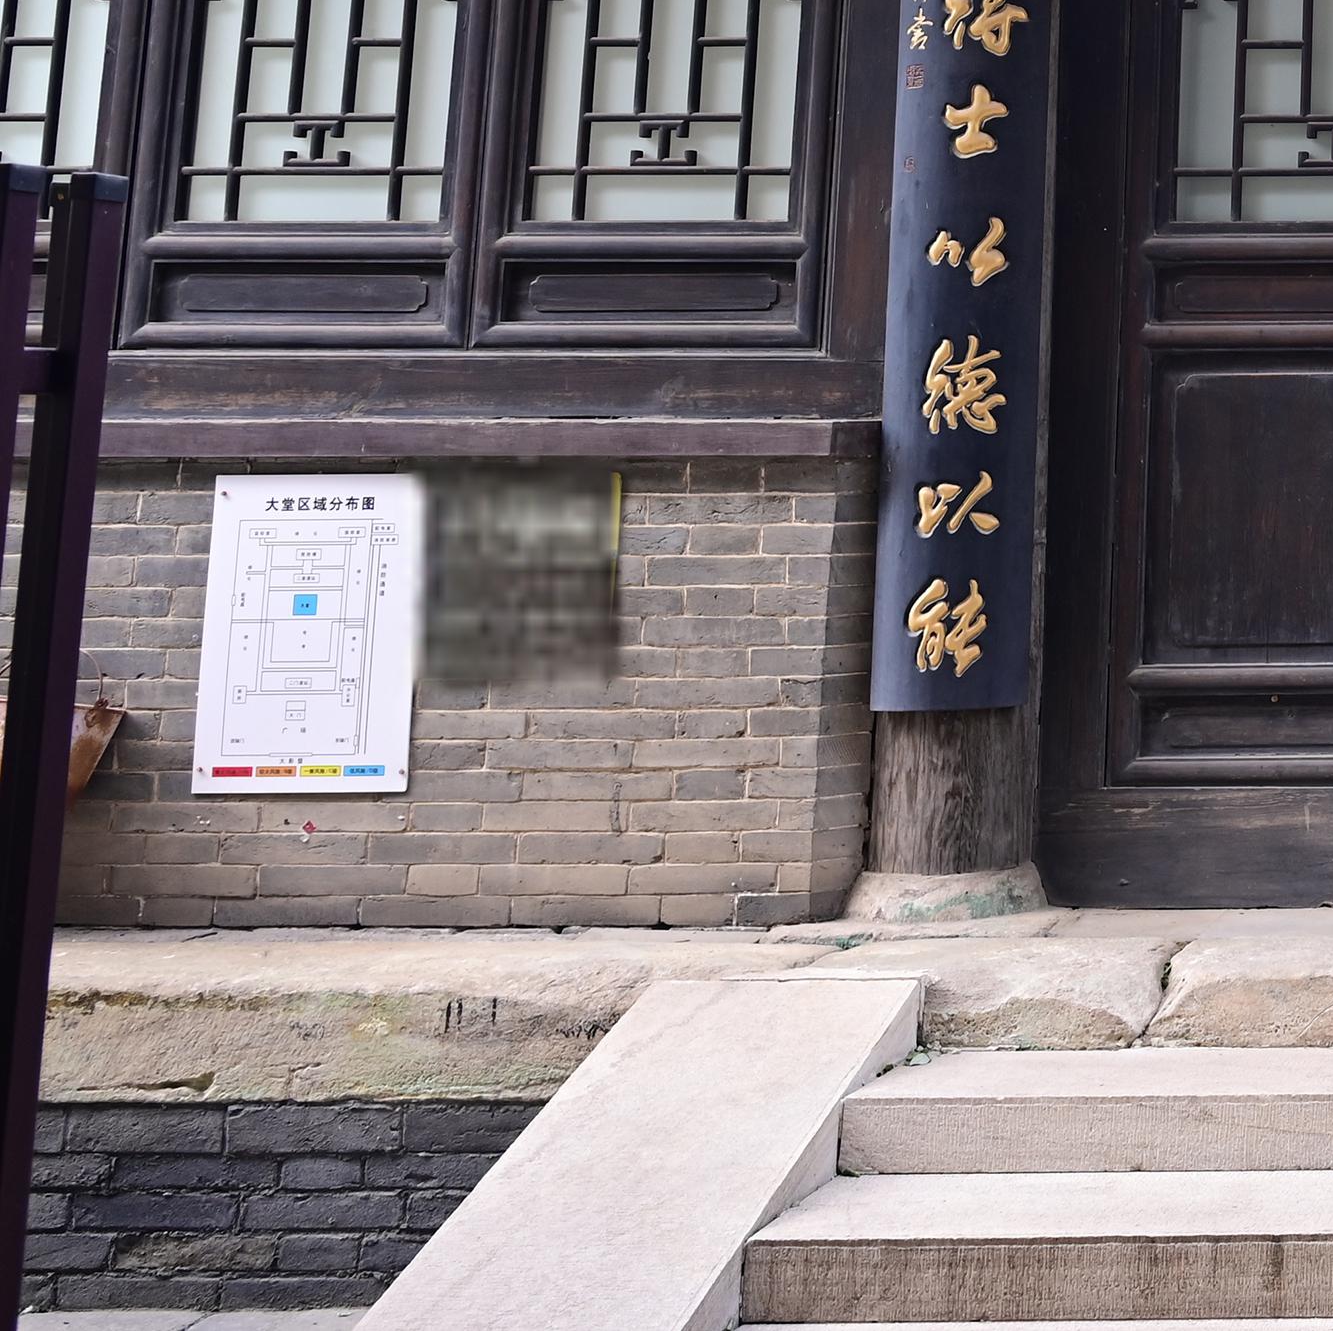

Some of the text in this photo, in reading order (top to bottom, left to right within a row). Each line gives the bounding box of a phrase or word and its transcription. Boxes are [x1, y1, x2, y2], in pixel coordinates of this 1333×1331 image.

[265, 496, 375, 511] 大堂区域分布图
